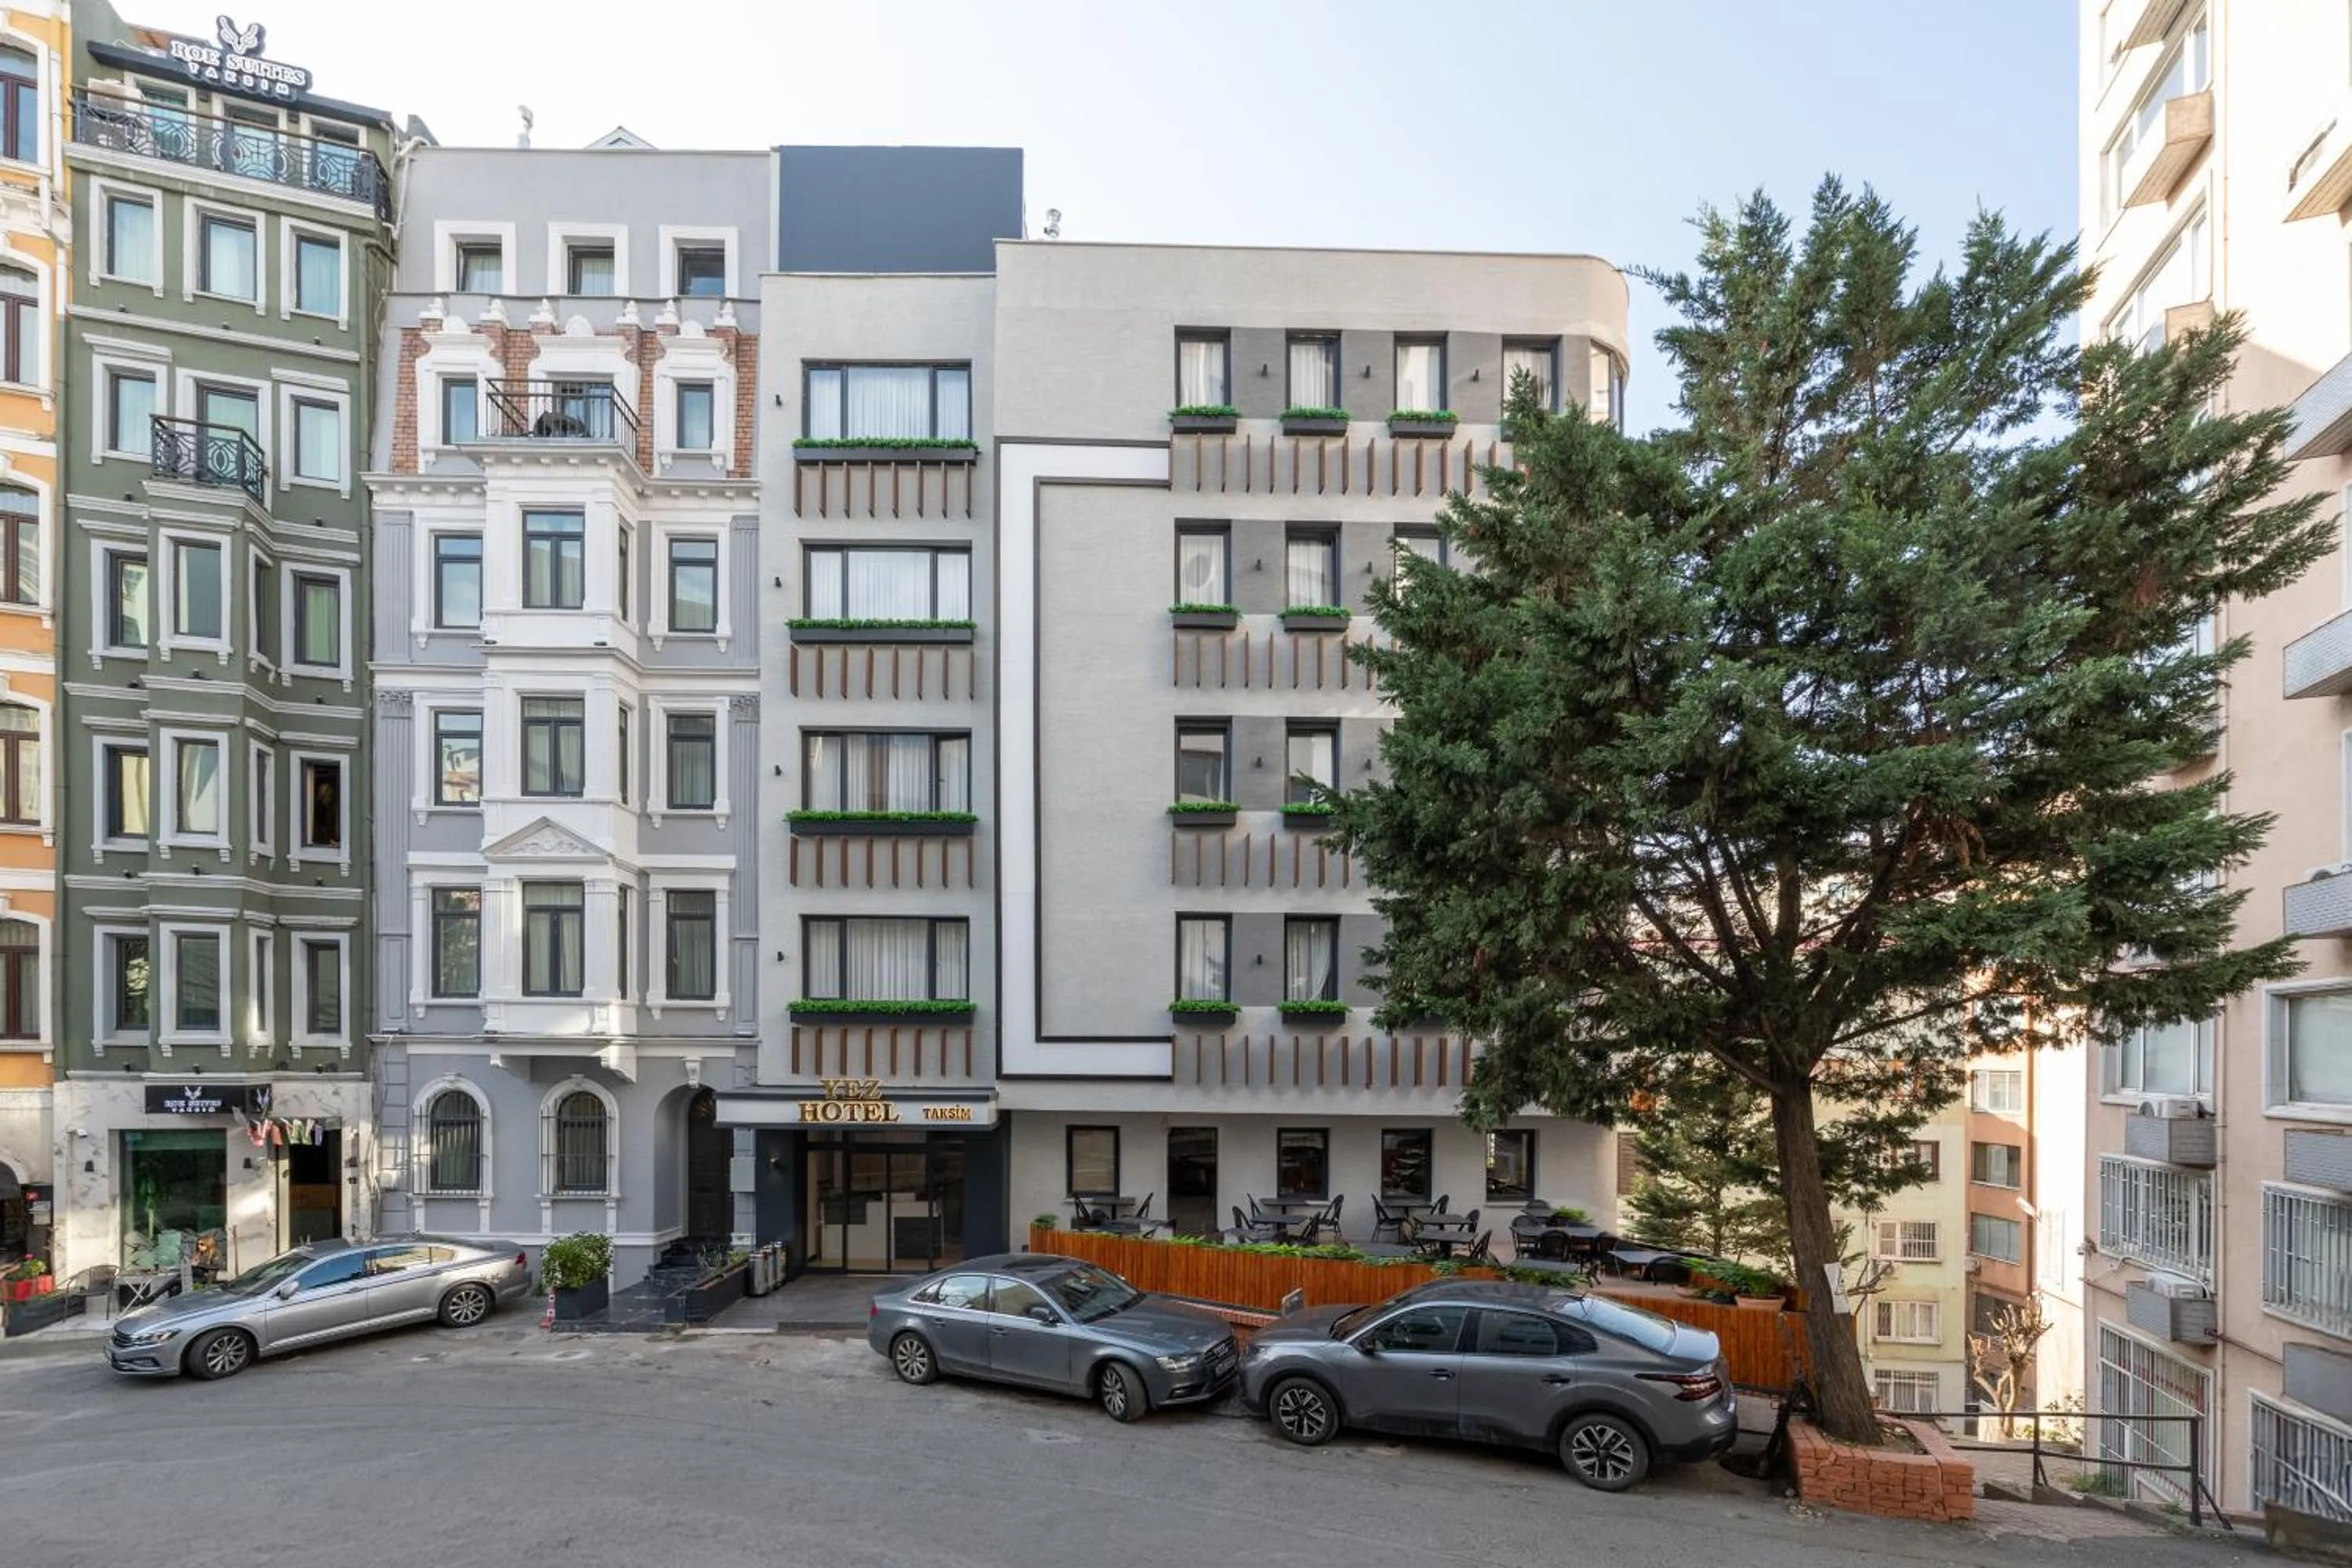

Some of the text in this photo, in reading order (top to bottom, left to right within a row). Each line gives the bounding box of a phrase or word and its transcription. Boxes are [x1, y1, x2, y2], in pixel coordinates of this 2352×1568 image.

[170, 40, 307, 85] ROE SUITES
[820, 1080, 882, 1100] YEZ
[799, 1101, 901, 1122] HOTEL
